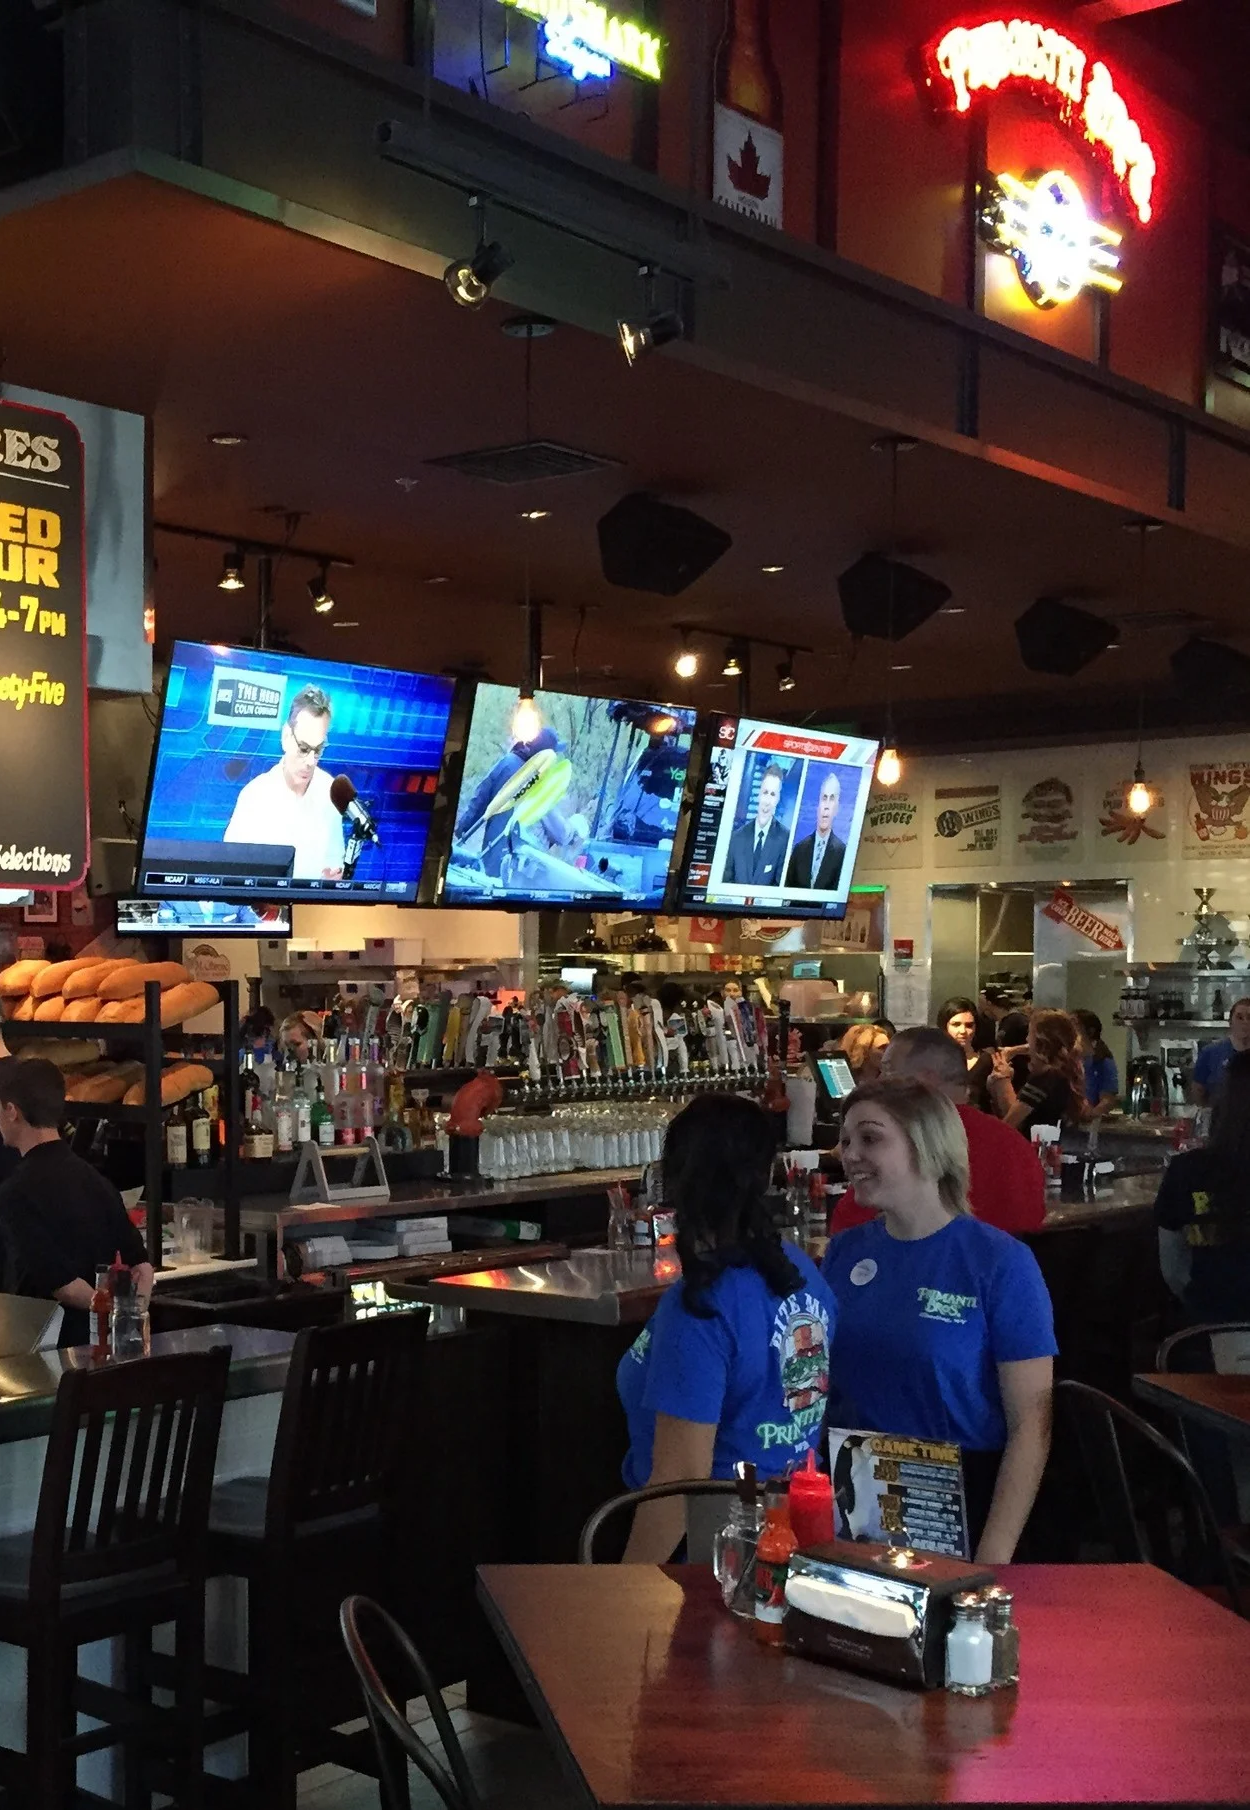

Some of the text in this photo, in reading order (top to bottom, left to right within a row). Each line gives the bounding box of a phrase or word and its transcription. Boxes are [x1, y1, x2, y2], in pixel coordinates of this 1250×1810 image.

[238, 682, 258, 701] THE
[719, 726, 735, 741] SC
[870, 811, 912, 828] WEDGES
[963, 804, 1000, 824] WINGS
[1065, 904, 1104, 941] BEER
[769, 1293, 801, 1349] BITE
[871, 1438, 959, 1463] GAME TIME
